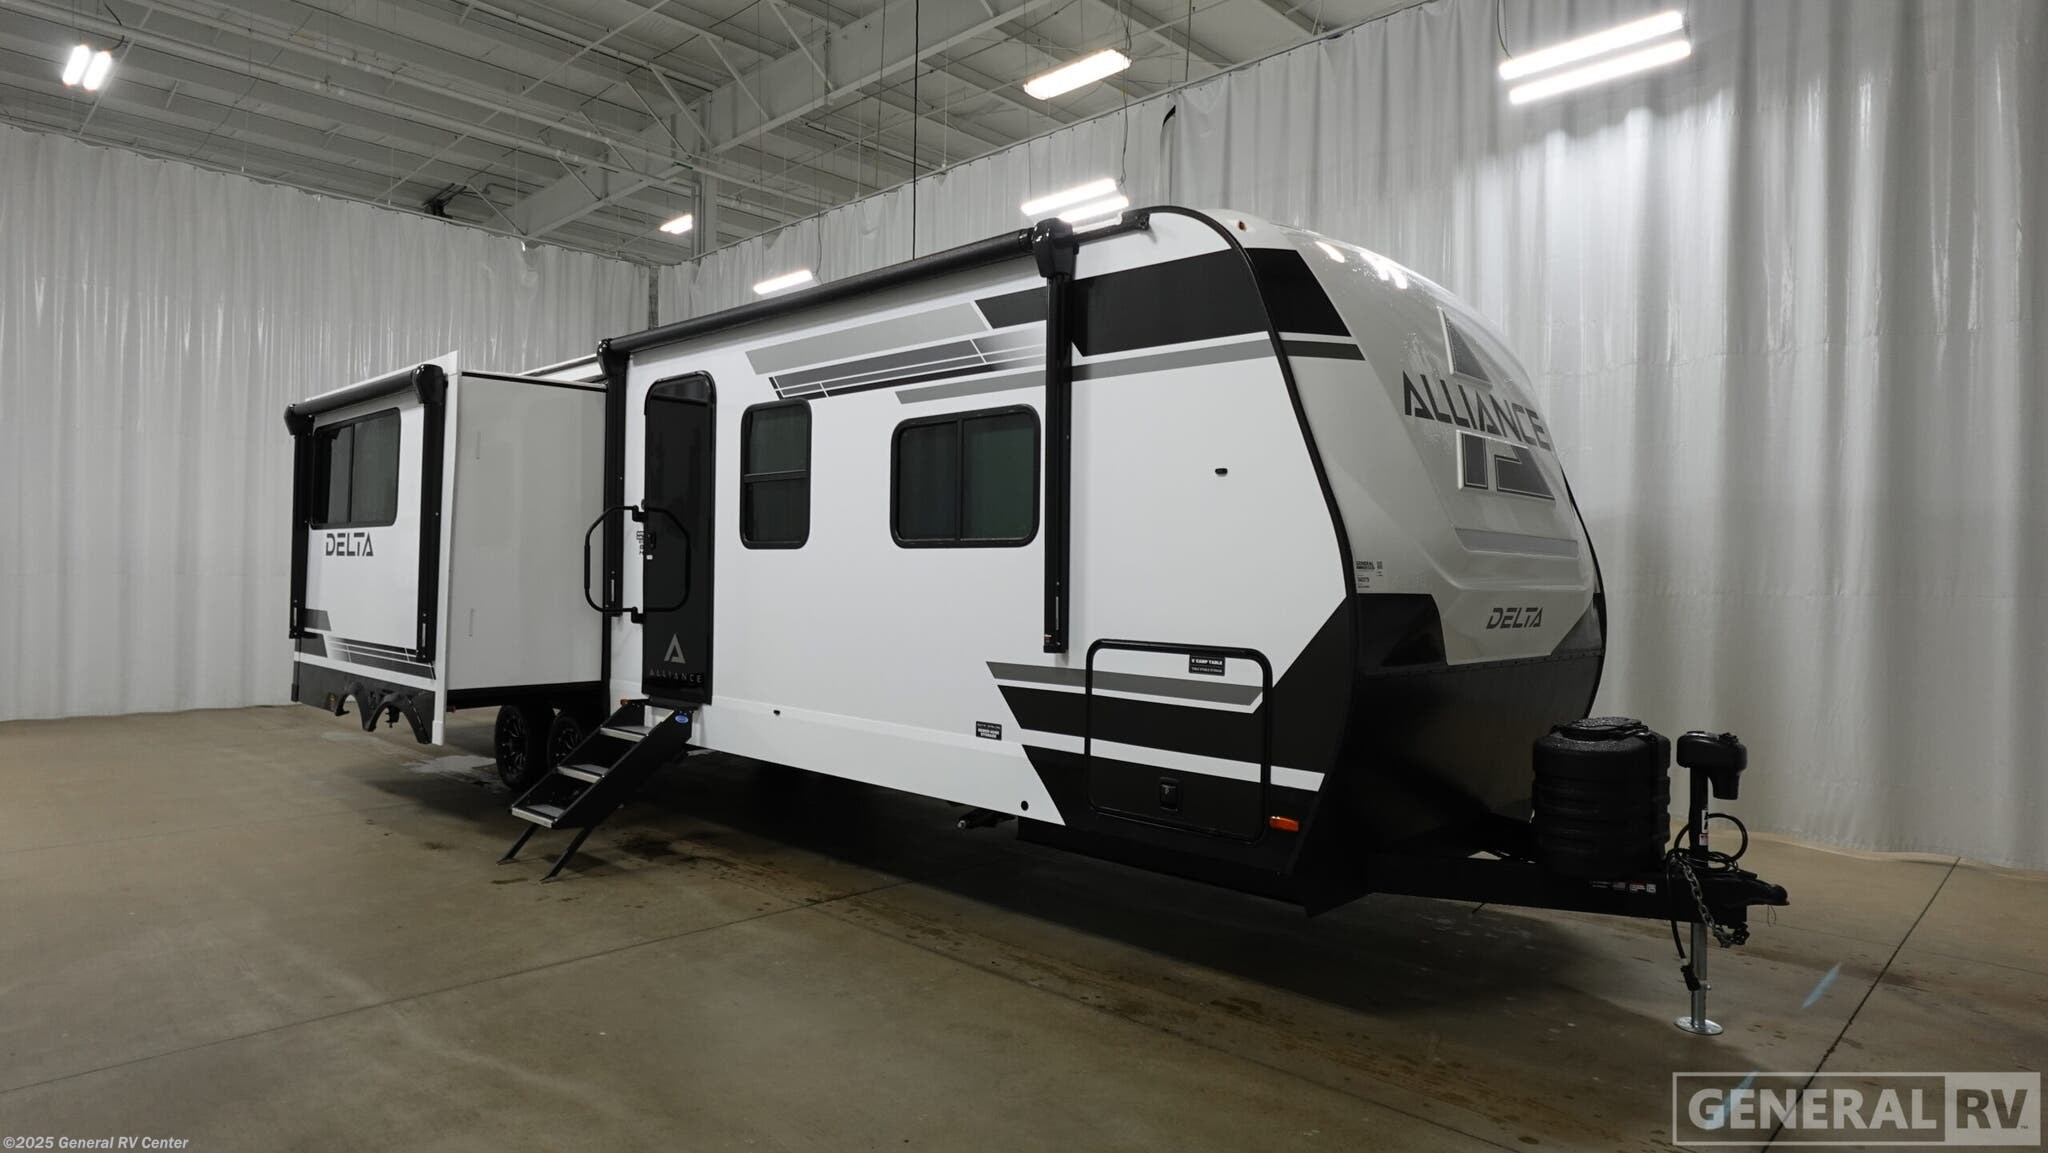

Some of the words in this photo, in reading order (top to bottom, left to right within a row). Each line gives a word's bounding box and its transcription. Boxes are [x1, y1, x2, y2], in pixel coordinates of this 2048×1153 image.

[1402, 369, 1552, 451] ALLIANCE
[325, 531, 374, 557] DELTA
[1486, 607, 1543, 630] DELTA
[648, 668, 703, 683] ALLIANCE
